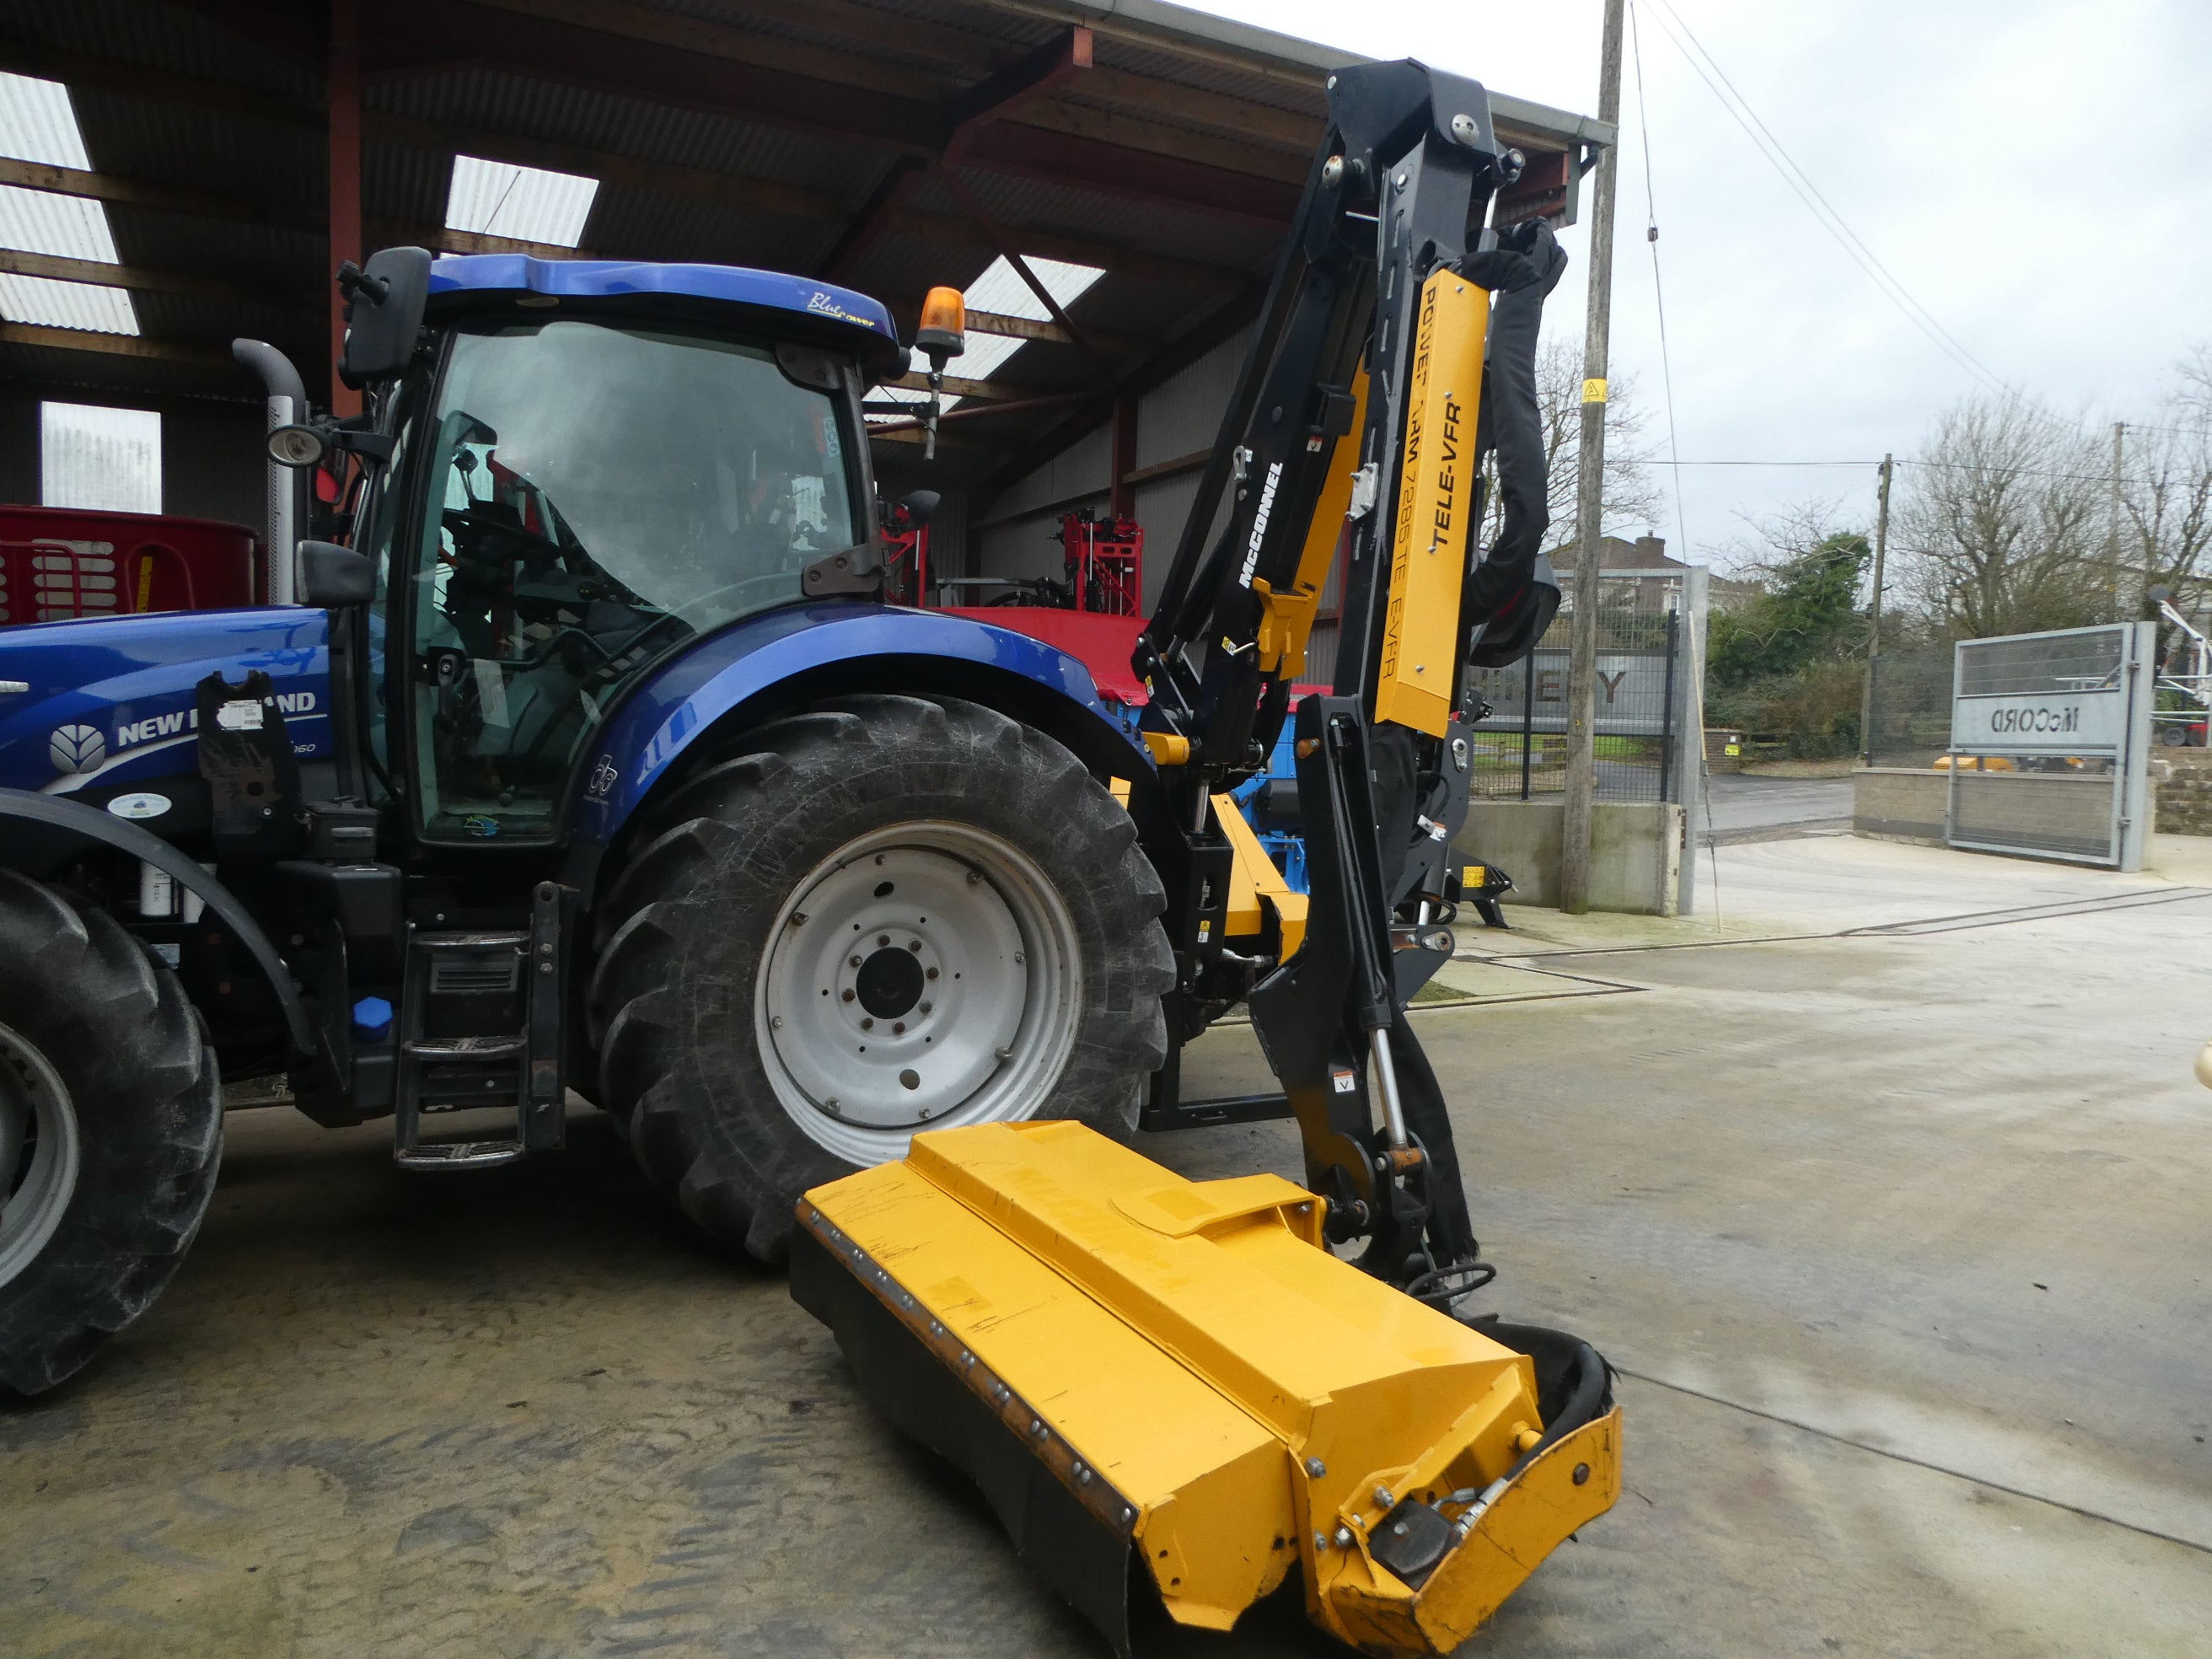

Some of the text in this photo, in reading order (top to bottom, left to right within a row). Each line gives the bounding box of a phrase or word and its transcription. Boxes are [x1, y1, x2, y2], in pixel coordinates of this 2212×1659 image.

[807, 292, 841, 314] Blue
[1432, 402, 1461, 548] TELE-VFR
[1399, 471, 1416, 543] 7285
[118, 711, 184, 747] NEW
